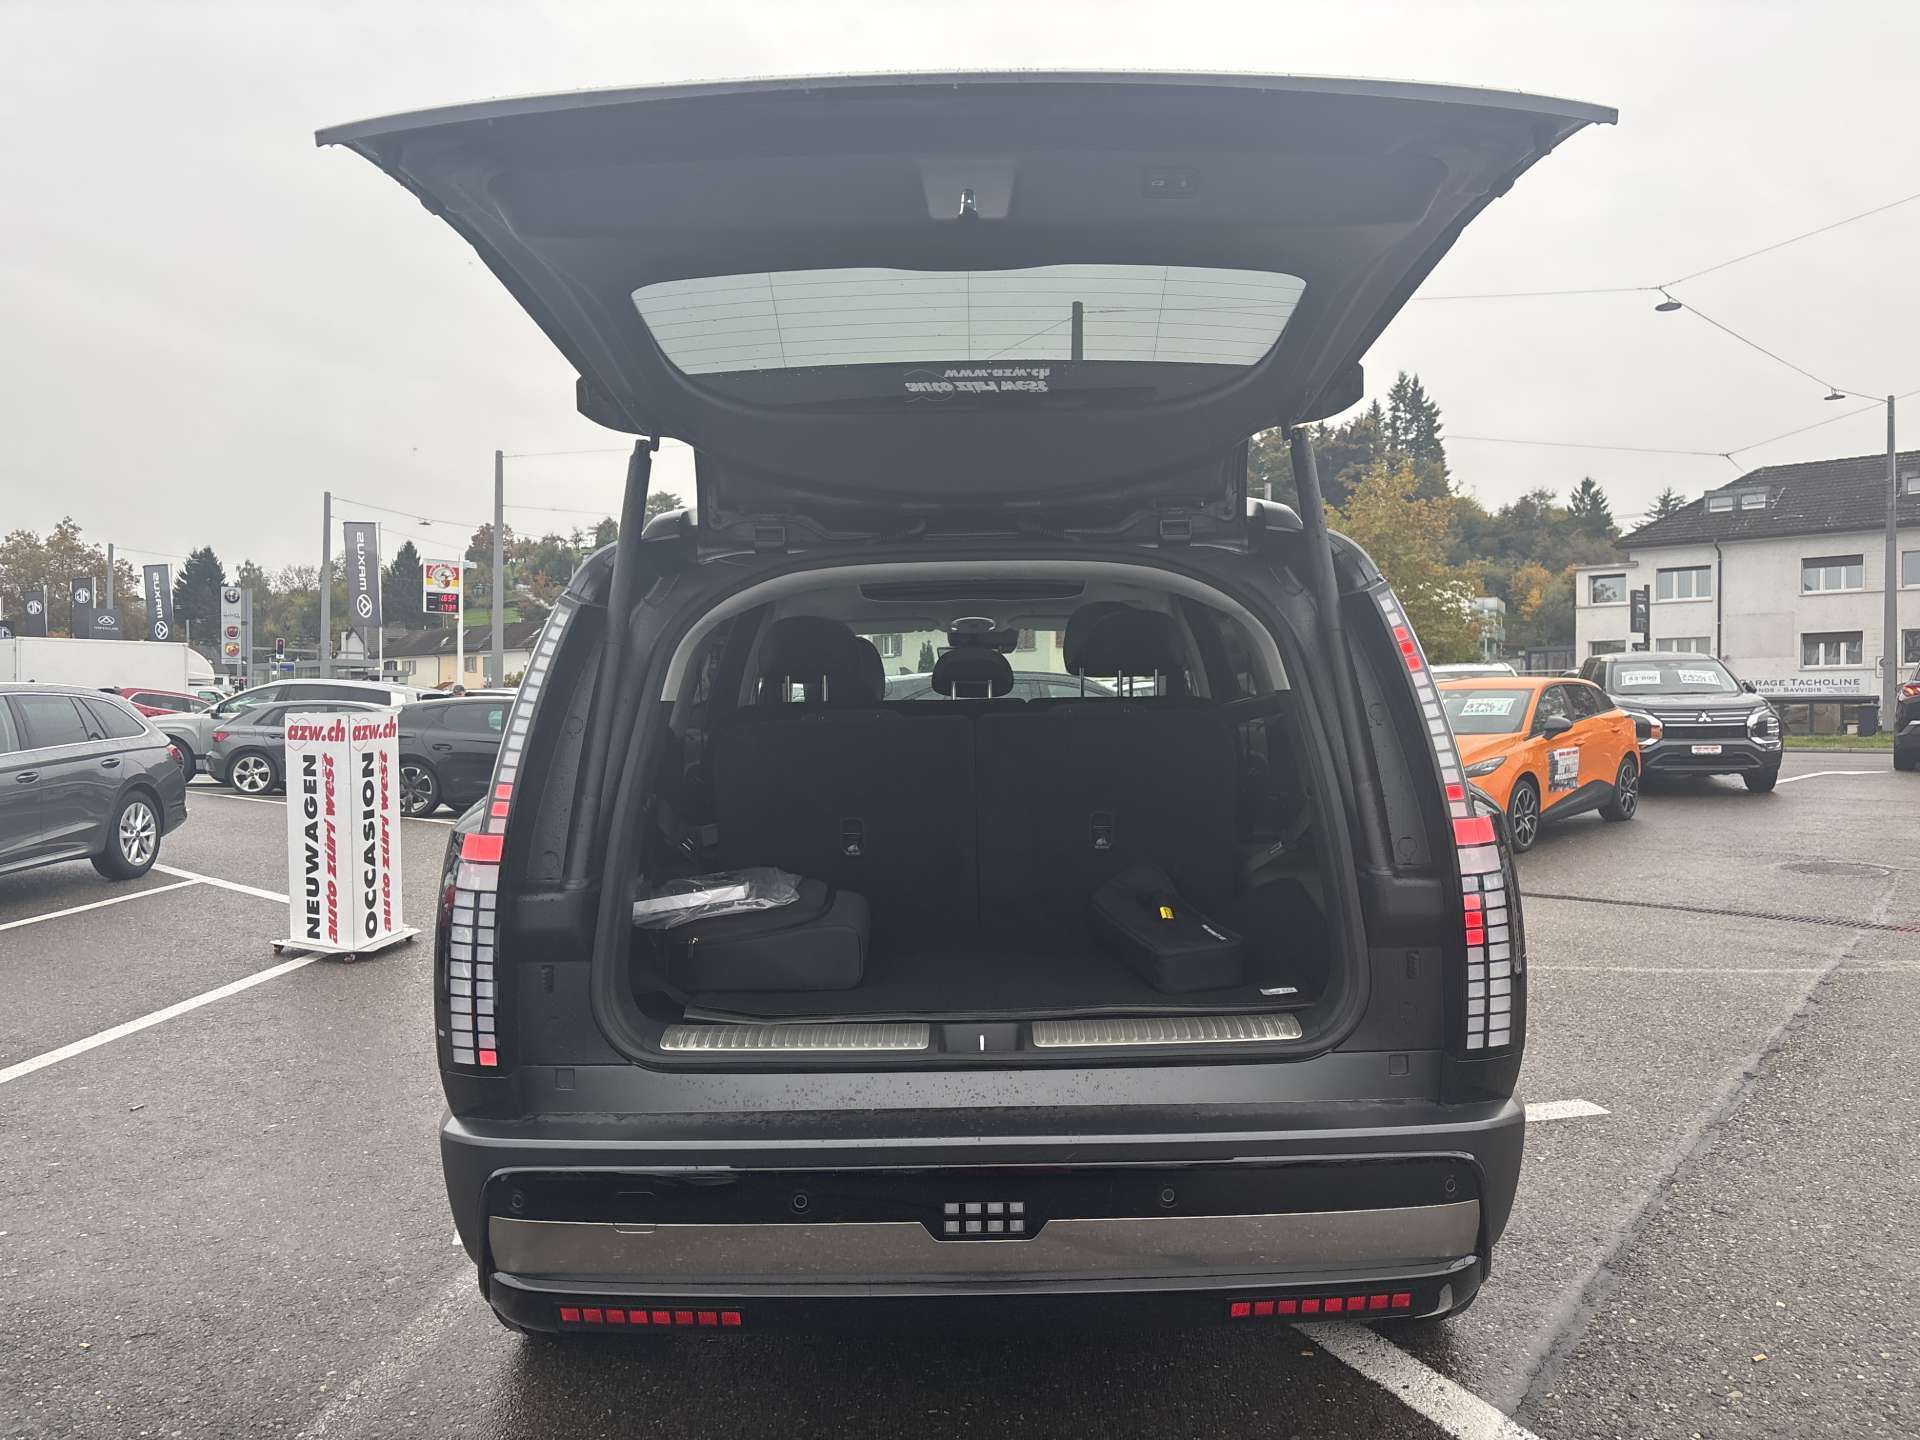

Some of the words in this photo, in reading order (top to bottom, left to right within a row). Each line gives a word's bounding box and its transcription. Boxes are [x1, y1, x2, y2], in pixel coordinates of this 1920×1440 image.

[1790, 678, 1861, 686] TACHOLINE
[287, 718, 346, 742] azw.ch
[352, 715, 397, 741] azw.ch
[323, 752, 335, 816] west
[379, 750, 389, 810] west
[303, 754, 321, 940] NEUWAGEN
[362, 752, 378, 938] OCCASION
[326, 880, 338, 945] auto
[382, 872, 392, 932] auto
